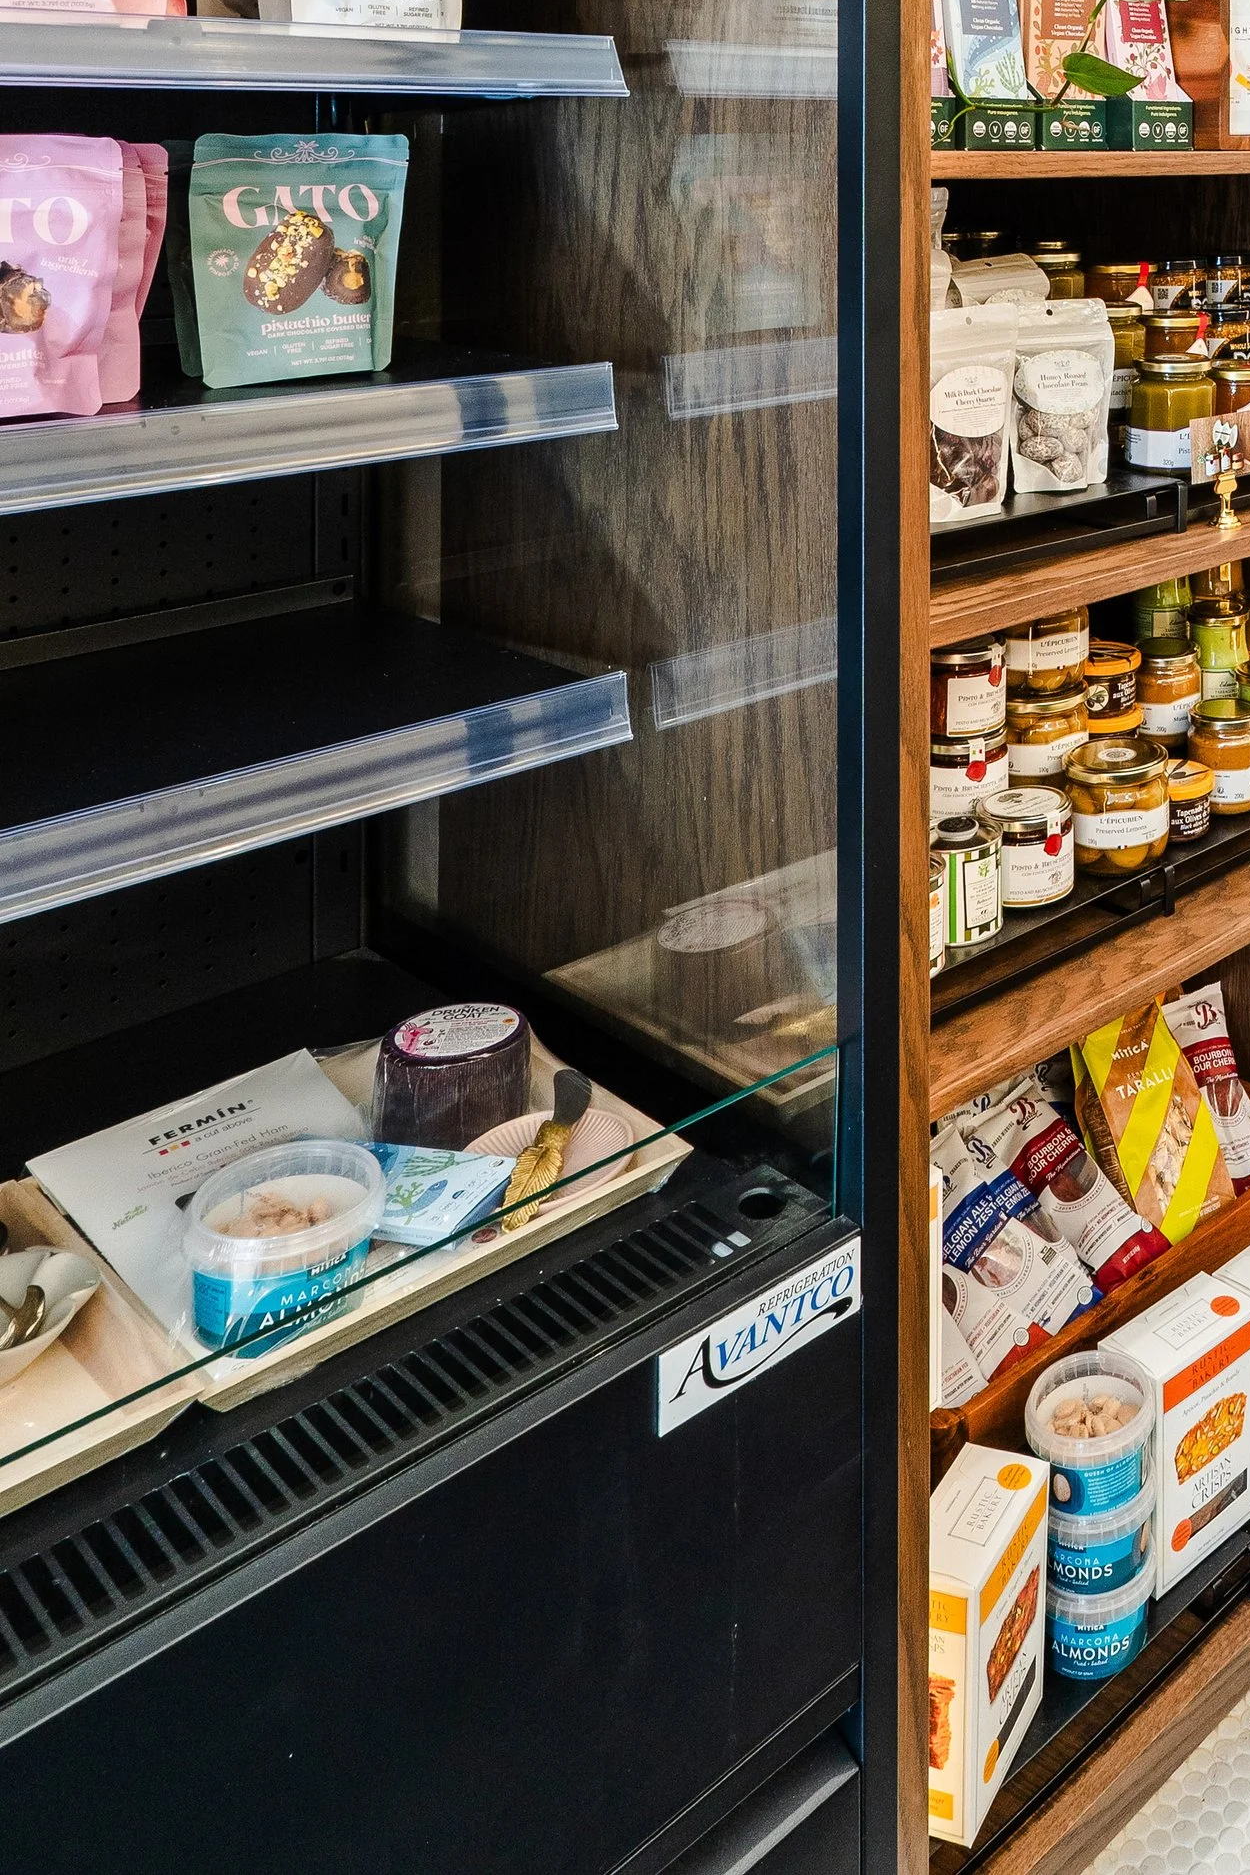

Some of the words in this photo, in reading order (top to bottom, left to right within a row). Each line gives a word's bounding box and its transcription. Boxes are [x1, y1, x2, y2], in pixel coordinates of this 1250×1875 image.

[367, 4, 390, 12] GLUTEN
[222, 183, 379, 229] GATO
[260, 316, 331, 337] pistachio
[332, 312, 372, 326] butter
[267, 330, 285, 339] DARK
[286, 328, 325, 337] CHOCOLATE
[325, 325, 354, 334] COVERED
[246, 348, 268, 357] VEGAN
[281, 342, 306, 350] GLUTEN
[1037, 381, 1070, 391] Chocolate
[1039, 373, 1062, 382] Honey
[944, 390, 958, 399] Milk
[955, 397, 975, 408] Cherry
[1035, 648, 1065, 658] Preserved
[1171, 817, 1185, 827] aux
[1185, 812, 1203, 824] Olives
[1176, 804, 1204, 818] Tapenade
[1099, 815, 1144, 826] L'ÉPICURIEN
[1095, 826, 1126, 836] Preserved
[1125, 824, 1148, 834] Lemons
[431, 1006, 501, 1017] DRUNKEN
[442, 1013, 483, 1021] GOAT
[1193, 1048, 1231, 1065] BOURBON
[1115, 1067, 1175, 1100] TARALLI
[203, 1129, 222, 1140] cut
[147, 1158, 194, 1181] Iberico
[195, 1132, 257, 1162] Grain-Fed
[258, 1123, 289, 1142] Ham
[1026, 1131, 1067, 1170] BOURBON
[1065, 1126, 1073, 1136] &
[1027, 1160, 1049, 1185] SOUR
[971, 1199, 990, 1221] ALE
[949, 1227, 979, 1264] LEMON
[972, 1241, 987, 1259] Beer
[756, 1248, 856, 1318] REFRIGERATION
[1170, 1309, 1202, 1334] RUSTIC
[1176, 1316, 1209, 1341] BAKERY
[668, 1264, 856, 1405] AVANTCO
[1191, 1341, 1230, 1376] RUSTIC
[1191, 1353, 1232, 1392] BAKERY
[1191, 1455, 1233, 1494] ARTISAN
[1190, 1467, 1233, 1511] CRISPS
[965, 1491, 993, 1529] RUSTIC
[975, 1495, 1003, 1531] BAKERY
[1051, 1635, 1130, 1661] ALMONDS
[1060, 1633, 1120, 1647] MARCONA
[1090, 1657, 1109, 1667] Salted
